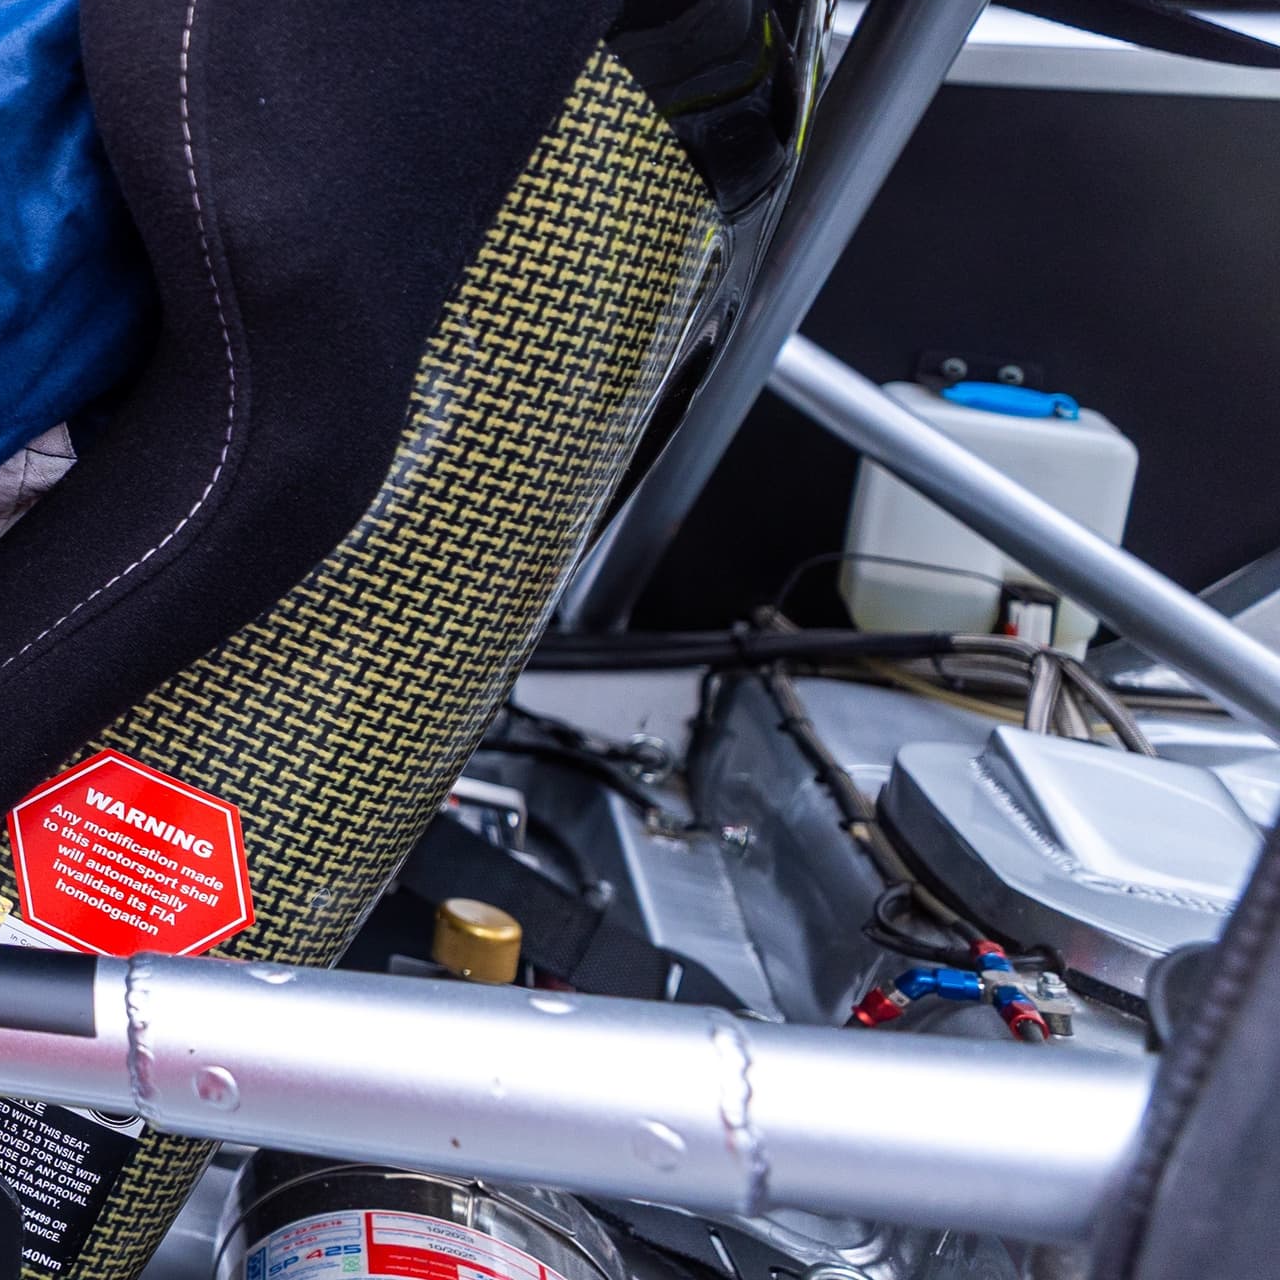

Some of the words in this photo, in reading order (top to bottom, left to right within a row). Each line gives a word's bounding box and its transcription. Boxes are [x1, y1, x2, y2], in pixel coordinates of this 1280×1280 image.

[85, 787, 214, 859] WARNING
[42, 817, 59, 832] to
[61, 826, 90, 848] this
[92, 843, 178, 889] motorsport
[180, 883, 219, 907] shell
[50, 804, 82, 826] Any
[83, 820, 178, 870] modification
[180, 865, 224, 891] made
[52, 858, 125, 901] invalidate
[126, 894, 147, 912] its
[150, 904, 176, 926] FIA
[58, 844, 85, 863] will
[85, 858, 188, 913] automatically
[55, 878, 159, 936] homologation
[11, 1108, 37, 1128] WITH
[39, 1122, 62, 1139] THIS
[62, 1134, 91, 1153] SEAT.
[22, 1128, 42, 1144] 12.9
[42, 1138, 85, 1164] TENSILE
[19, 1157, 36, 1168] OF
[35, 1164, 58, 1179] ANY
[58, 1174, 92, 1195] OTHER
[31, 1147, 54, 1165] FOR
[53, 1157, 75, 1174] USE
[75, 1168, 101, 1184] WITH
[17, 1169, 34, 1184] FIA
[34, 1176, 88, 1207] APPROVAL
[51, 1219, 68, 1232] OR
[426, 1225, 475, 1245] 10/2023
[269, 1255, 299, 1277] SP
[305, 1243, 362, 1261] 425
[428, 1242, 478, 1262] 10/2025
